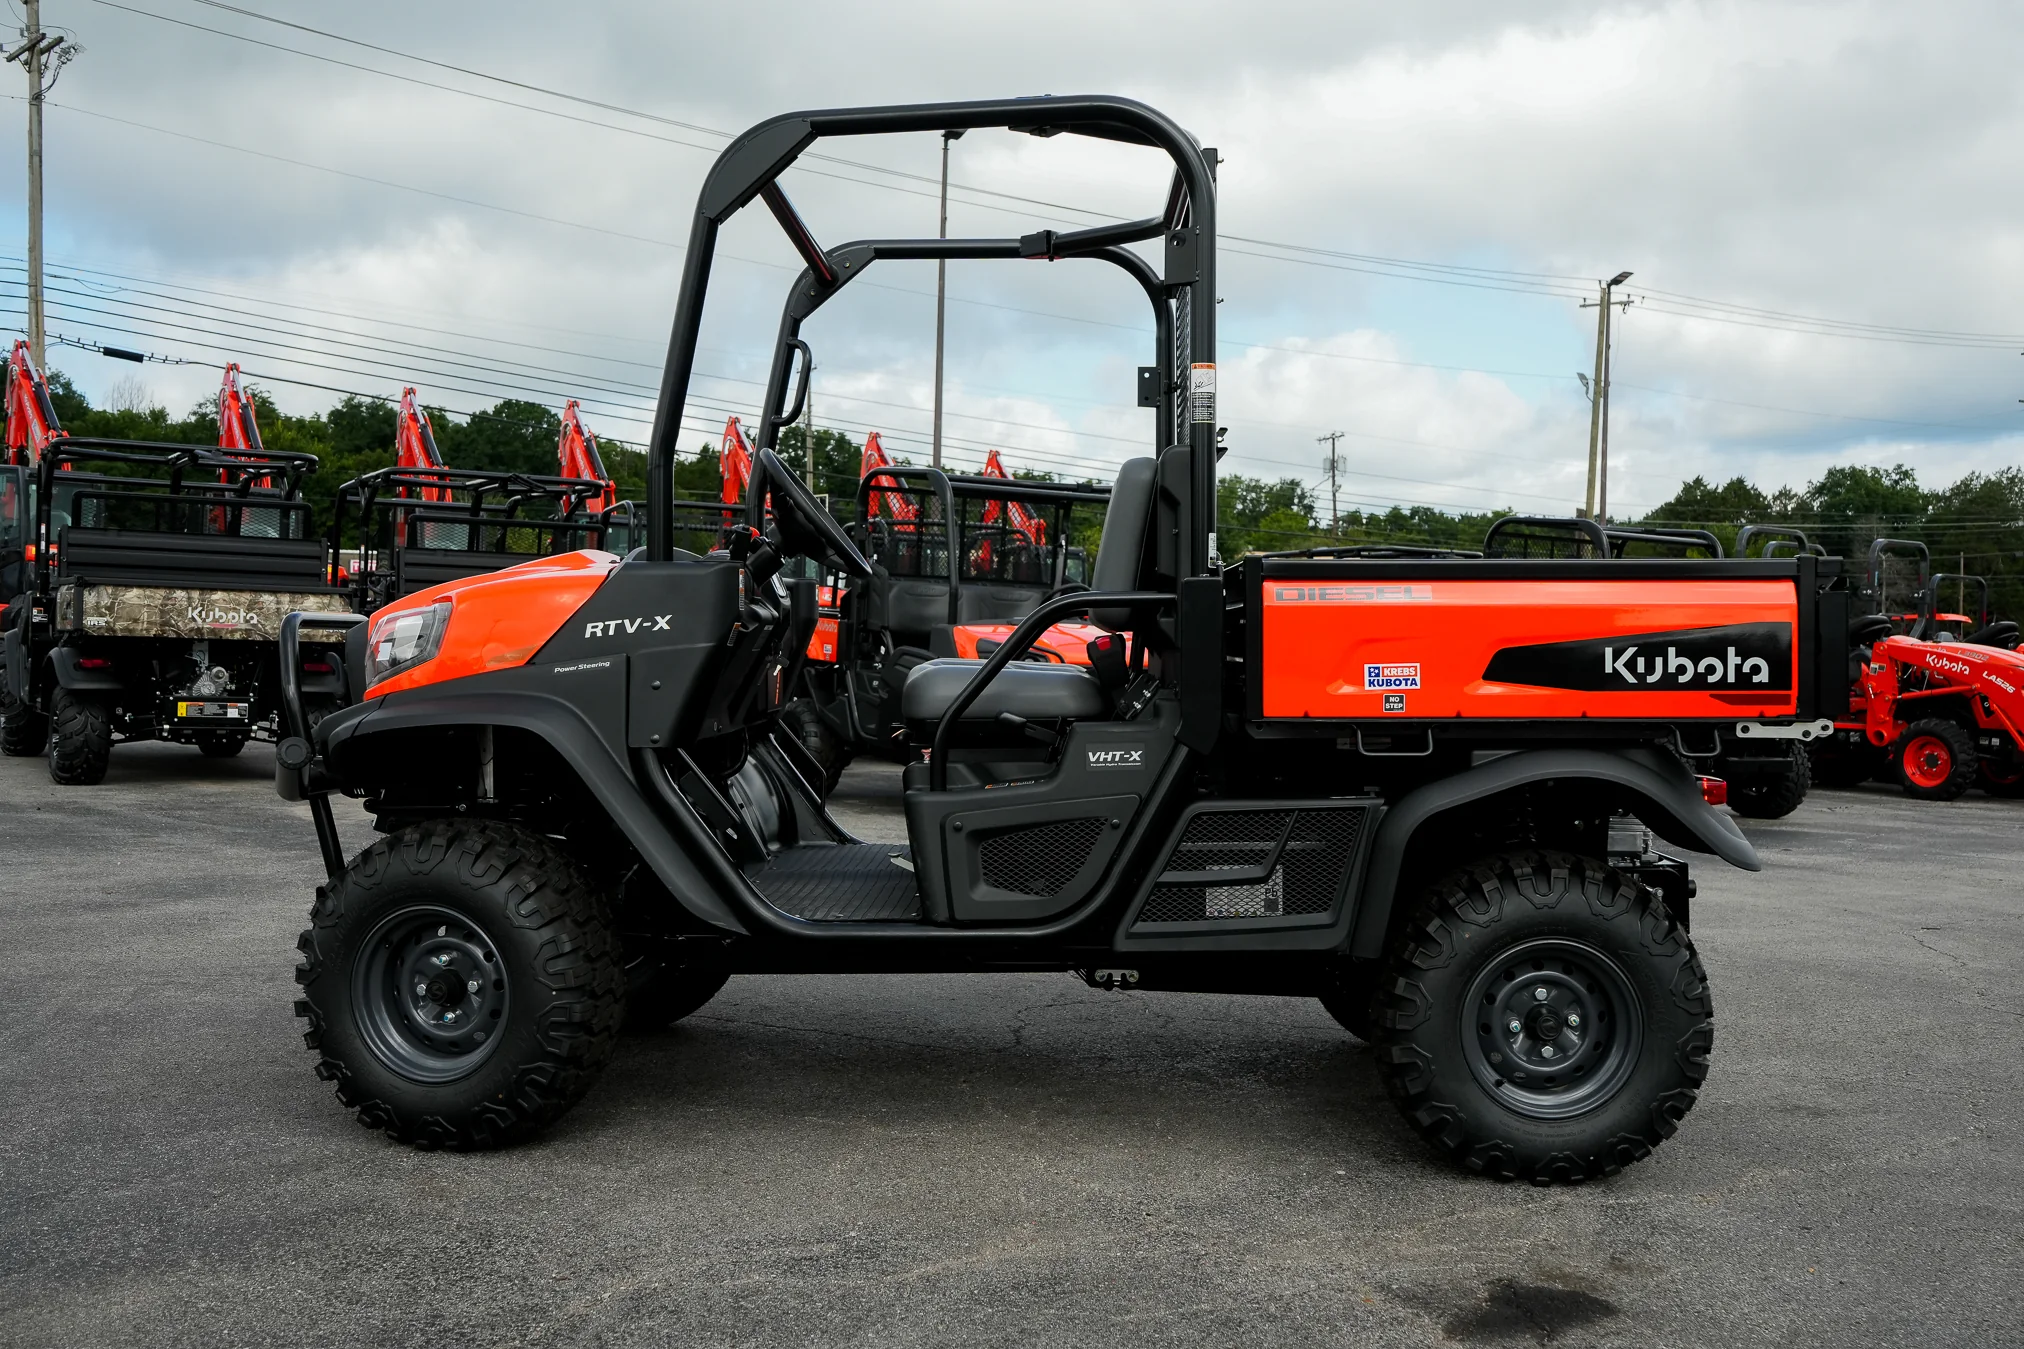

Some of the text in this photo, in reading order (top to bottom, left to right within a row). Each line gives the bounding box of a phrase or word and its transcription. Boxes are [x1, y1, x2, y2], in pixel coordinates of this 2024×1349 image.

[1275, 586, 1432, 602] DIESEL
[188, 606, 258, 624] Kubota
[584, 614, 673, 639] RTV-X
[554, 660, 611, 674] Power Steering
[1384, 667, 1415, 676] KREBS
[1604, 646, 1769, 684] Kubota
[1926, 653, 1970, 675] Kubota
[1368, 678, 1418, 687] KUBOTA
[1982, 670, 2017, 694] LA526
[1088, 750, 1143, 762] VHT-X
